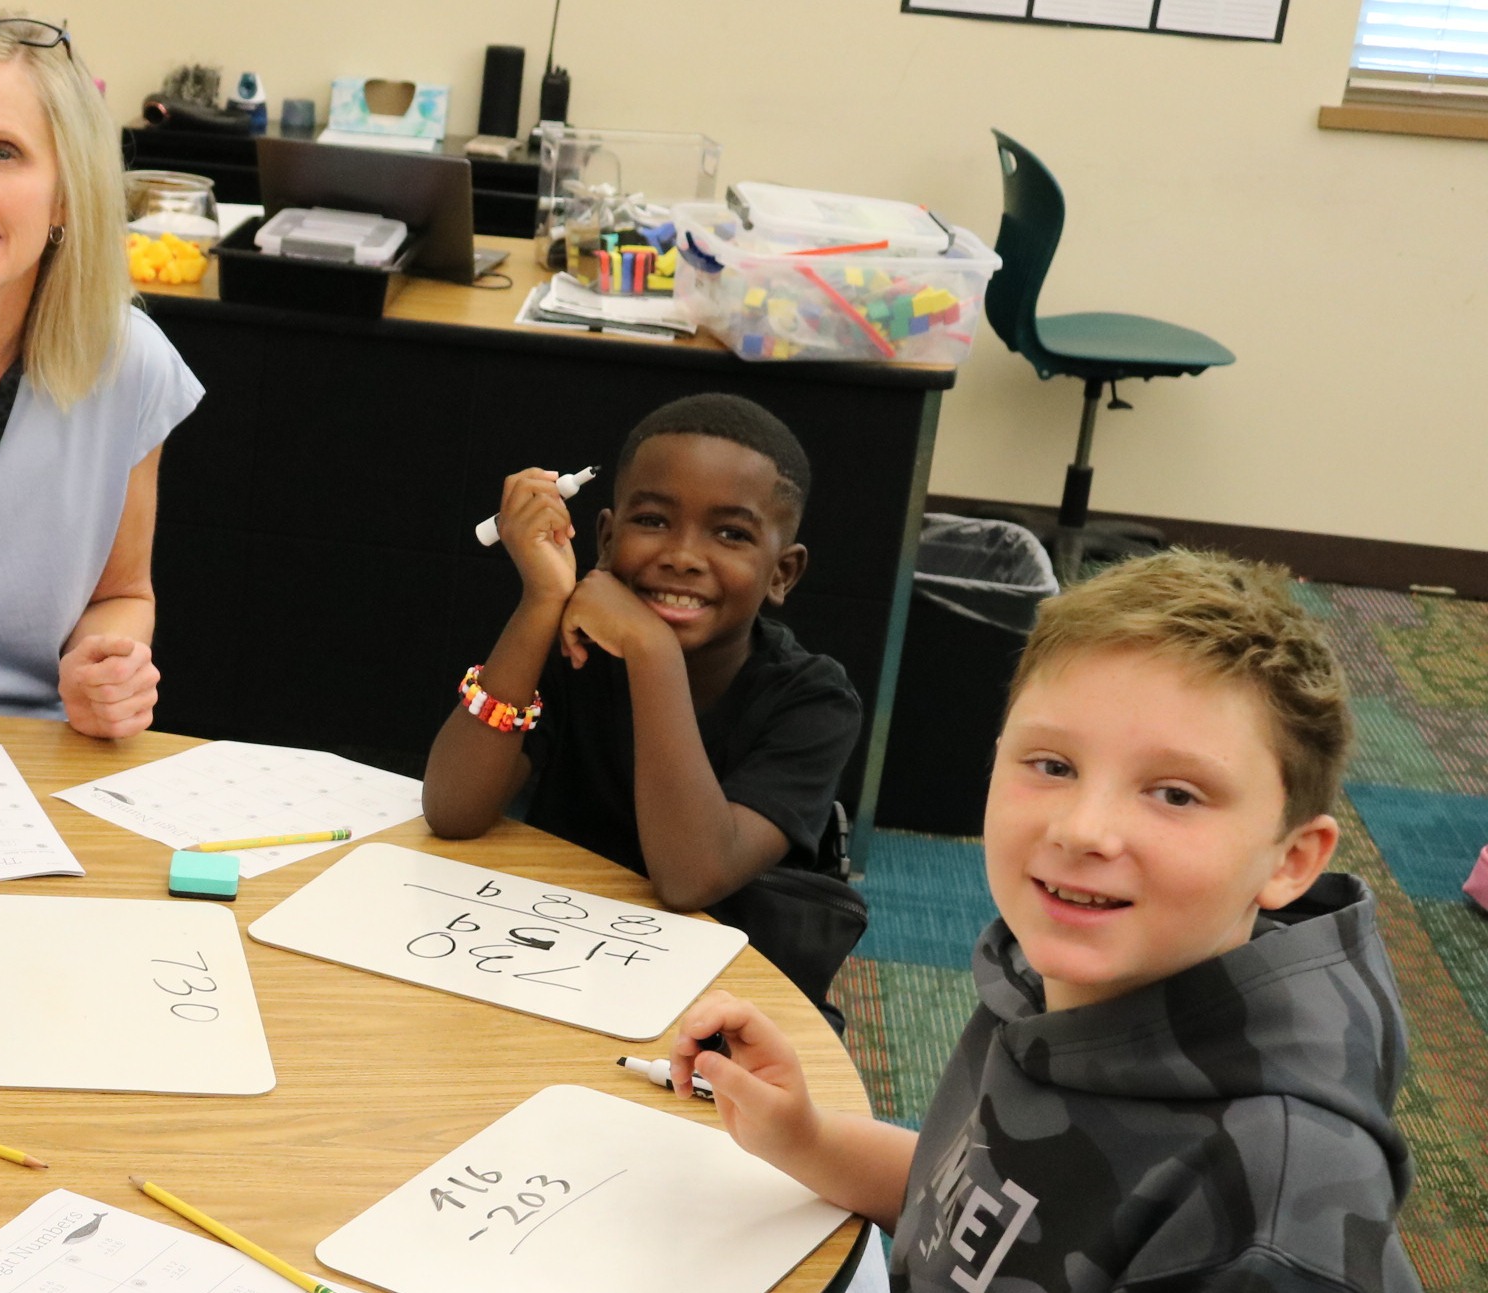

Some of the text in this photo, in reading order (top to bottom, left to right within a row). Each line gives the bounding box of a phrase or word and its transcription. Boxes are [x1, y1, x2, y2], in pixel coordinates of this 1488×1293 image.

[150, 950, 220, 1023] 730
[430, 1165, 503, 1212] 416
[10, 1210, 84, 1261] Numbers
